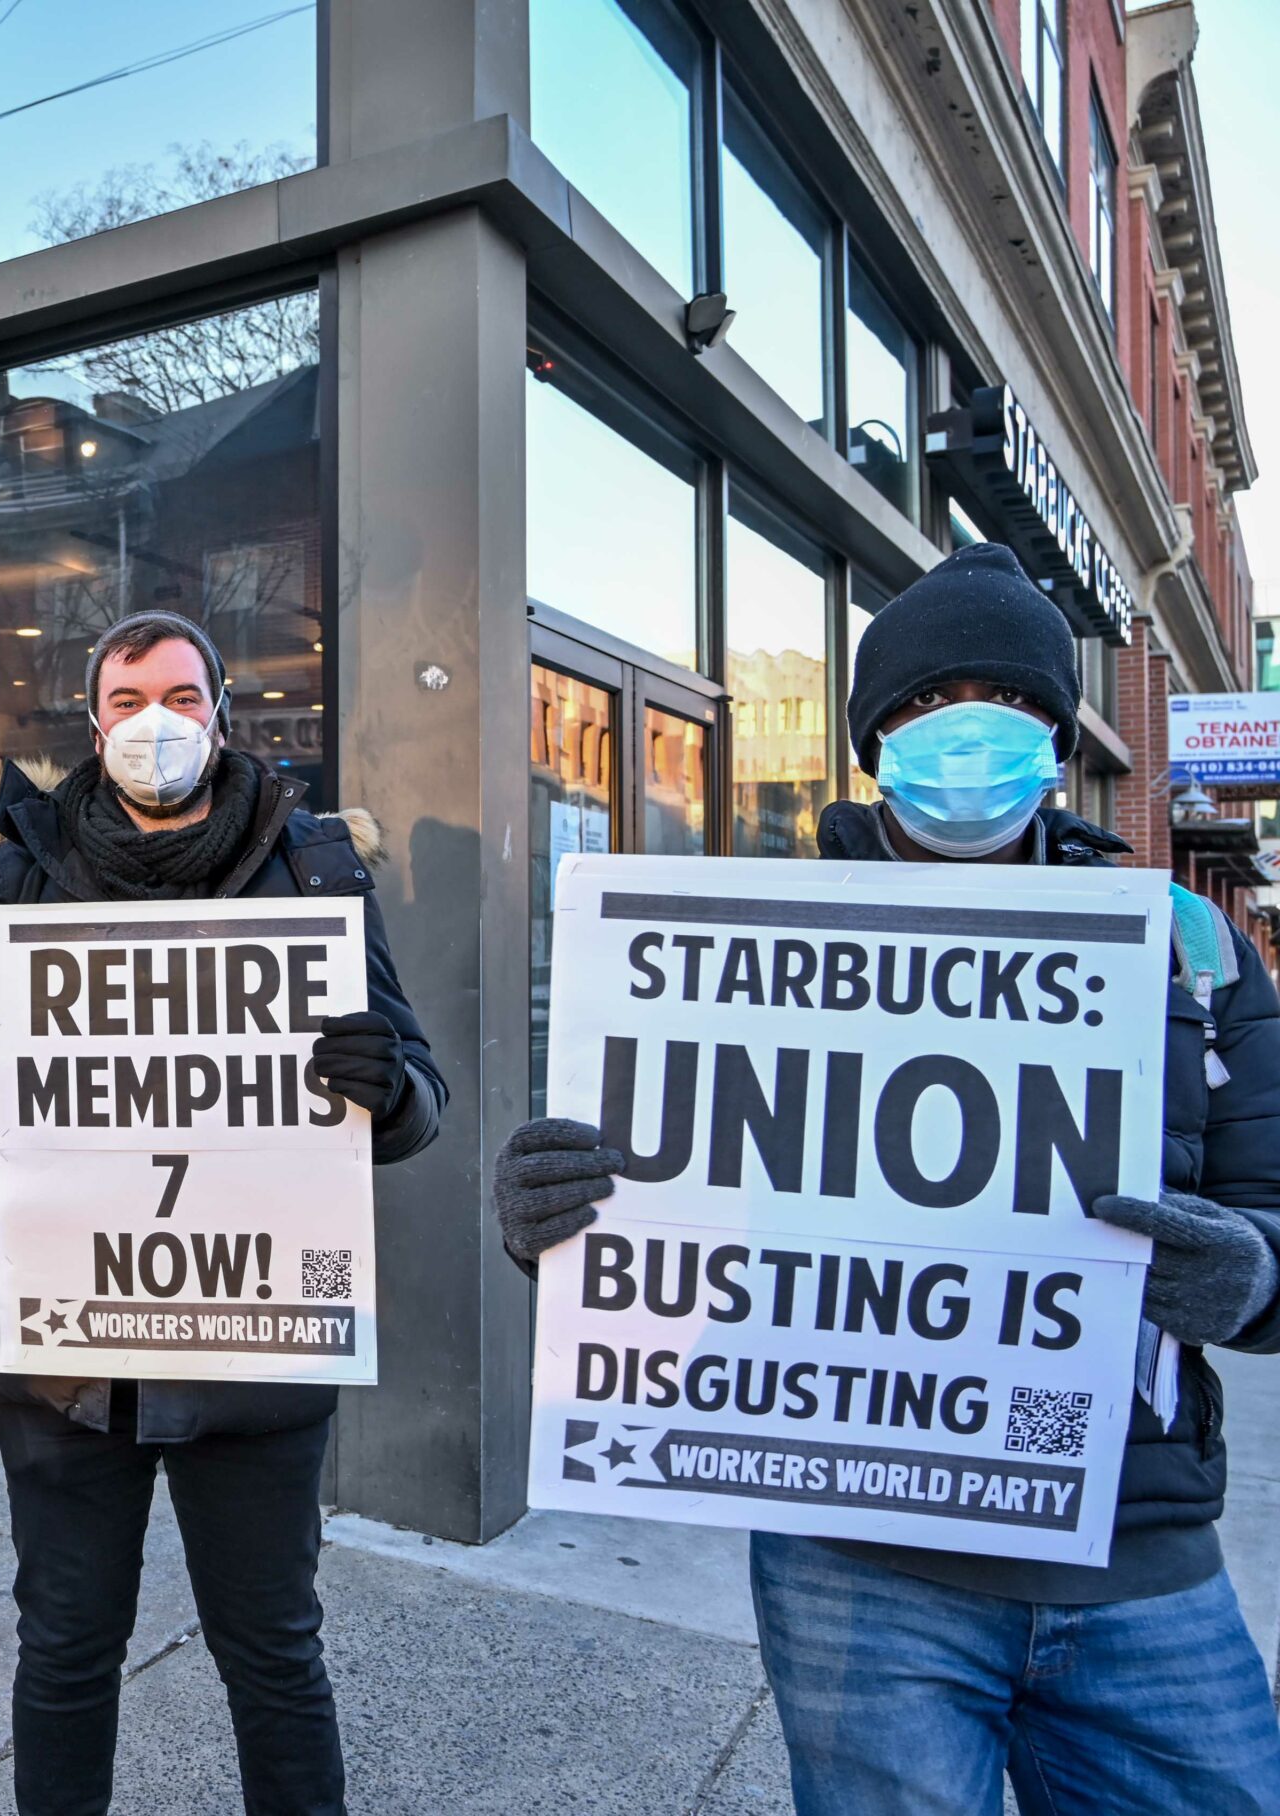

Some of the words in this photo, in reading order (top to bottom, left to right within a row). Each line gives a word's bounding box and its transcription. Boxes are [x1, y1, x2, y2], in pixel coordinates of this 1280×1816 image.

[1003, 383, 1091, 590] STARBUCKS
[1094, 542, 1133, 647] COFFEE
[1185, 735, 1280, 749] OBTAINE
[1197, 720, 1280, 734] TENANT
[29, 943, 329, 1037] REHIRE
[626, 930, 1106, 1028] STARBUCKS:
[16, 1053, 348, 1128] MEMPHIS
[600, 1035, 1124, 1220] UNION
[151, 1153, 190, 1219] 7
[92, 1231, 273, 1300] NOW!
[581, 1232, 971, 1341] BUSTING
[996, 1269, 1084, 1351] IS
[87, 1311, 194, 1341] WORKERS
[197, 1313, 274, 1343] WORLD
[278, 1316, 351, 1345] PARTY
[574, 1341, 989, 1436] DISGUSTING
[667, 1442, 830, 1491] WORKERS
[835, 1457, 952, 1504] WORLD
[959, 1471, 1076, 1517] PARTY
